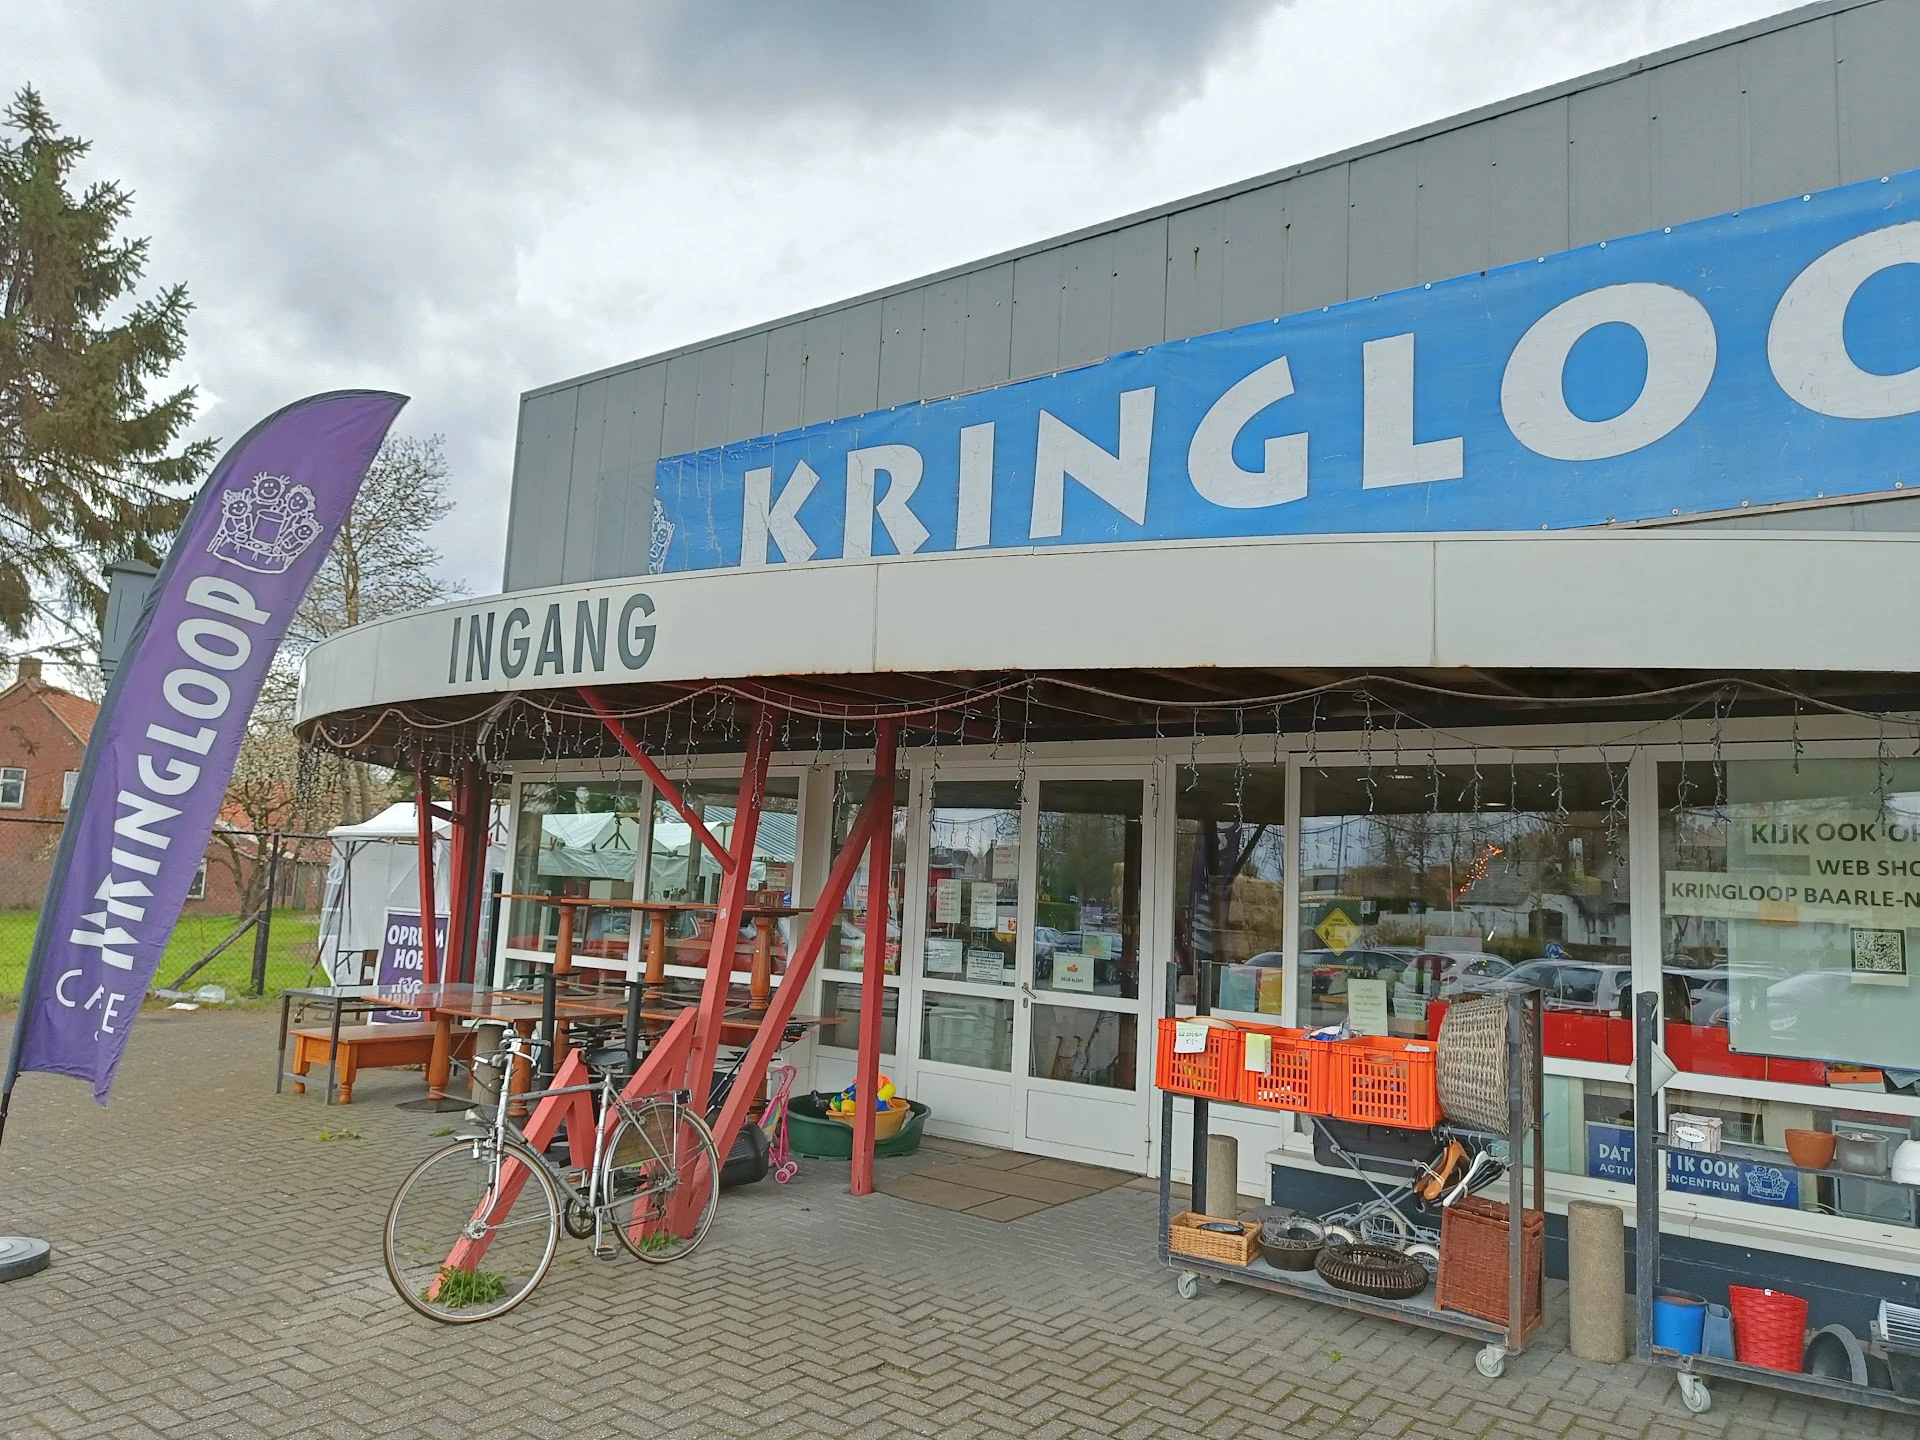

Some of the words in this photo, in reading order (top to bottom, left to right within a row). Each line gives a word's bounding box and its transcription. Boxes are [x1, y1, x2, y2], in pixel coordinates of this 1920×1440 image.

[449, 593, 657, 684] INGANG
[69, 575, 272, 971] KRINGLOOP
[1752, 823, 1809, 845] KIJK
[1816, 823, 1876, 842] OOK
[1816, 860, 1870, 876] WEB
[1877, 860, 1920, 877] SHO
[1671, 882, 1798, 902] KRINGLOOP
[1804, 887, 1920, 908] BAARLE-N
[393, 948, 424, 970] HOE
[1599, 1143, 1631, 1163] DAT
[1677, 1155, 1697, 1173] IK
[1700, 1158, 1740, 1180] OOK
